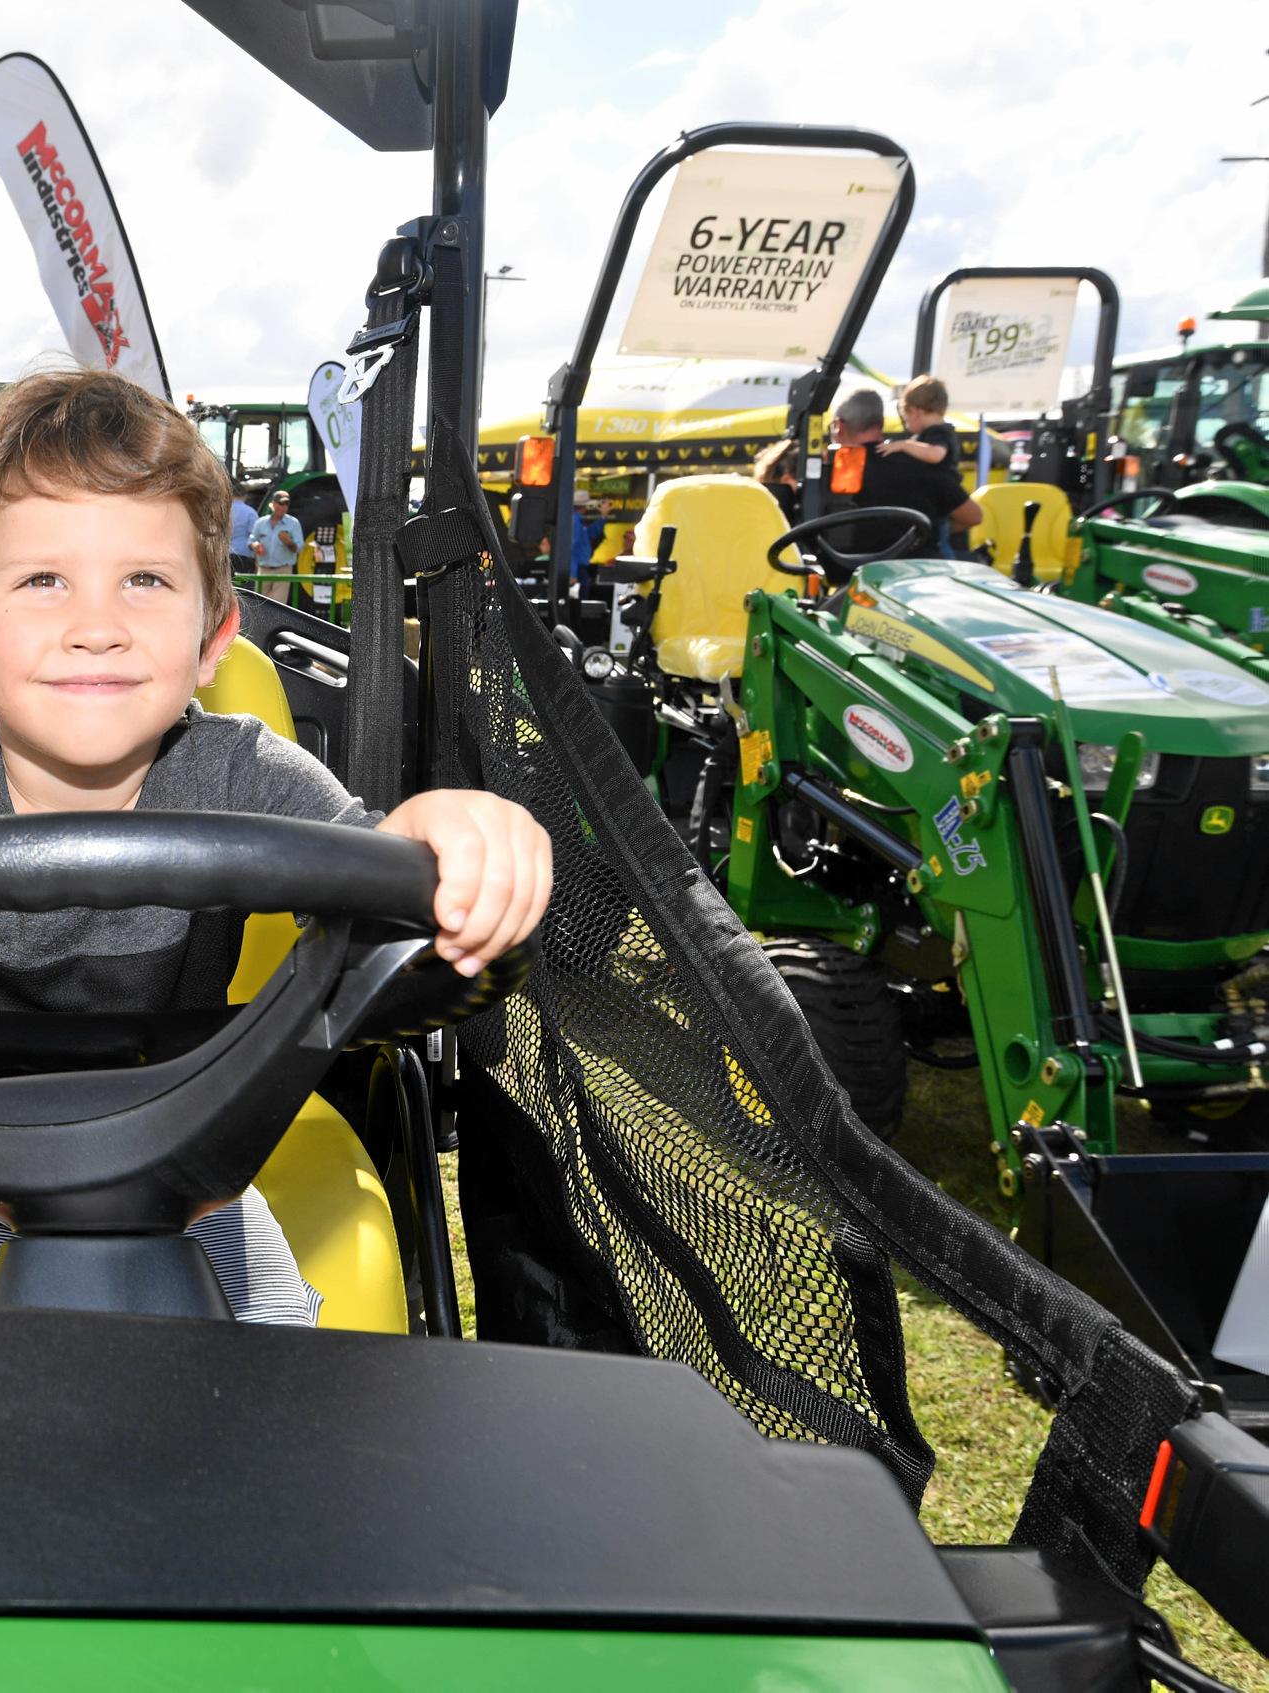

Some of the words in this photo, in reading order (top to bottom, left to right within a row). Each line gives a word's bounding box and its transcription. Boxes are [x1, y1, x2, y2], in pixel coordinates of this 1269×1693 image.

[690, 215, 846, 255] 6-YEAR
[675, 254, 834, 279] POWERTRAIN
[673, 275, 822, 302] WARRANTY
[679, 299, 695, 309] ON
[697, 301, 746, 311] LIFESTYLE
[749, 302, 798, 313] TRACTORS
[850, 616, 879, 637] JOHN
[881, 620, 914, 650] DEERE
